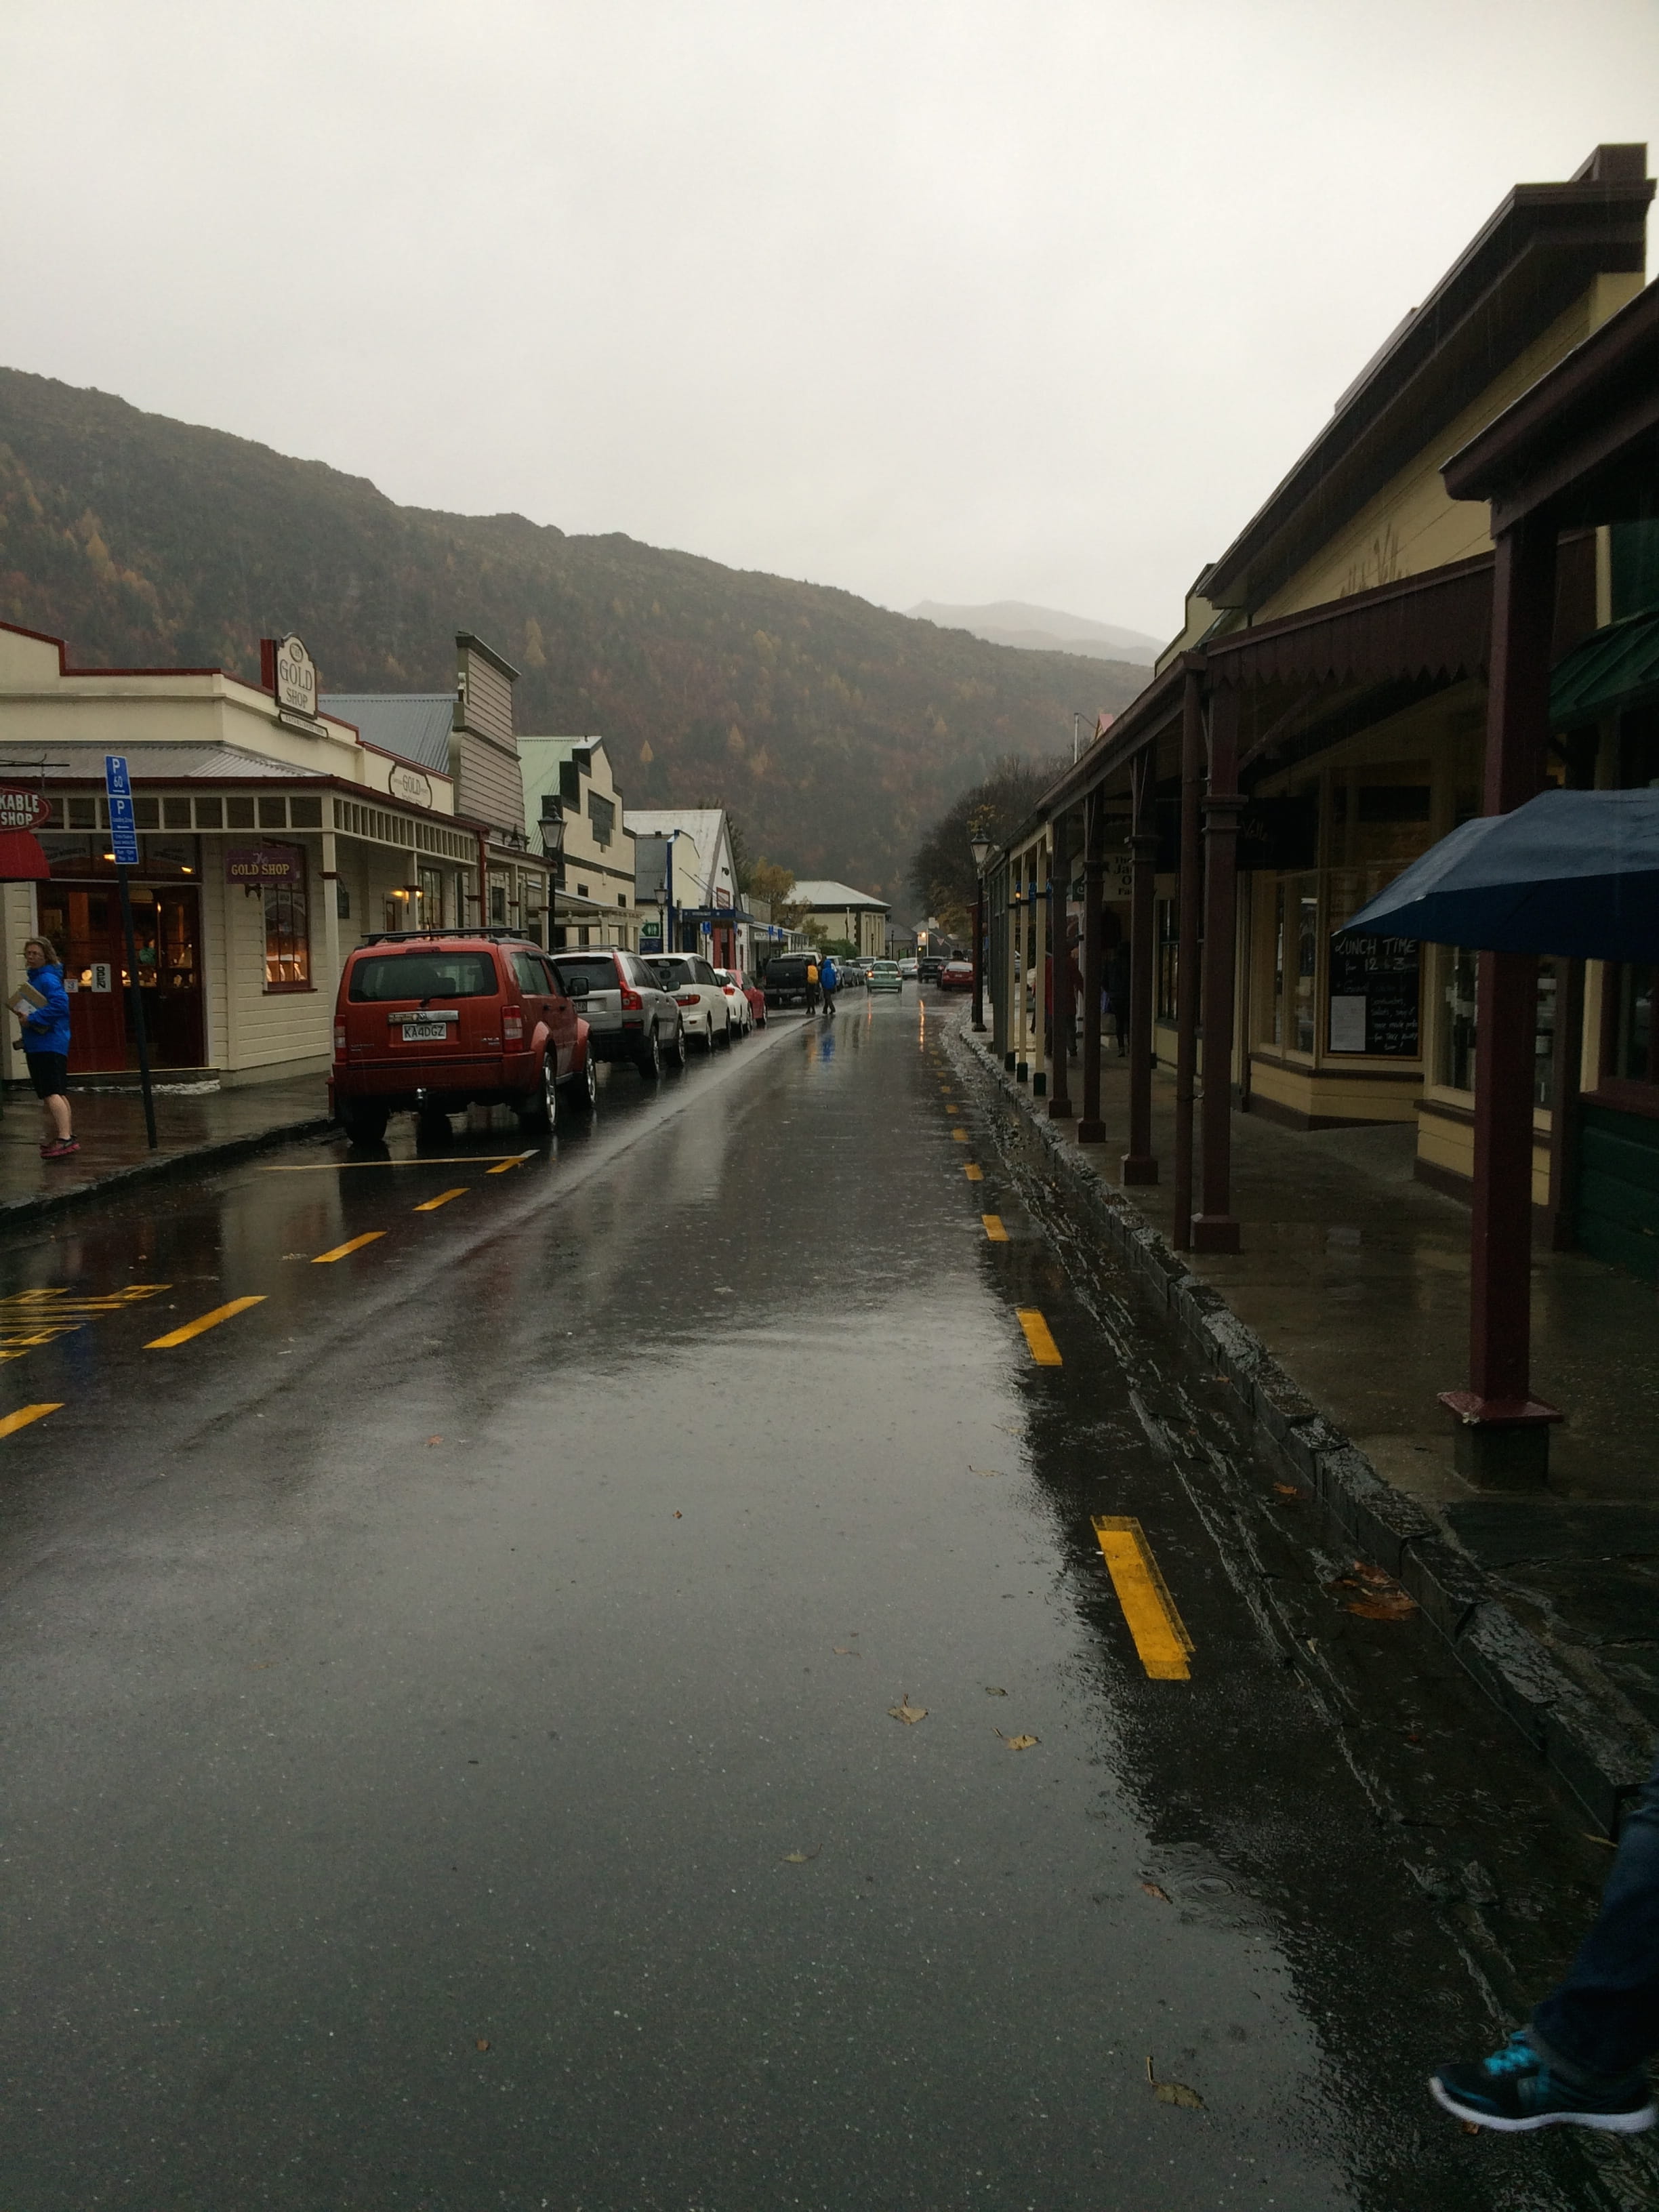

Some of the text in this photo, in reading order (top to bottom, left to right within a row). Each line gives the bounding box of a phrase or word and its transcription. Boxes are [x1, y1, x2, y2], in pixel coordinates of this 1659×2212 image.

[280, 659, 312, 691] GOLD
[286, 687, 308, 708] SHOP
[111, 758, 121, 774] P
[113, 776, 123, 787] 60
[403, 774, 421, 796] GOLD
[0, 794, 40, 813] KABLE
[116, 800, 125, 815] P
[1, 811, 33, 825] SHOP
[231, 863, 289, 876] GOLD SHOP
[1335, 937, 1377, 955] LUNCH
[1364, 957, 1378, 972] 12
[96, 966, 106, 989] OPEN
[404, 1025, 445, 1038] KA4DGZ
